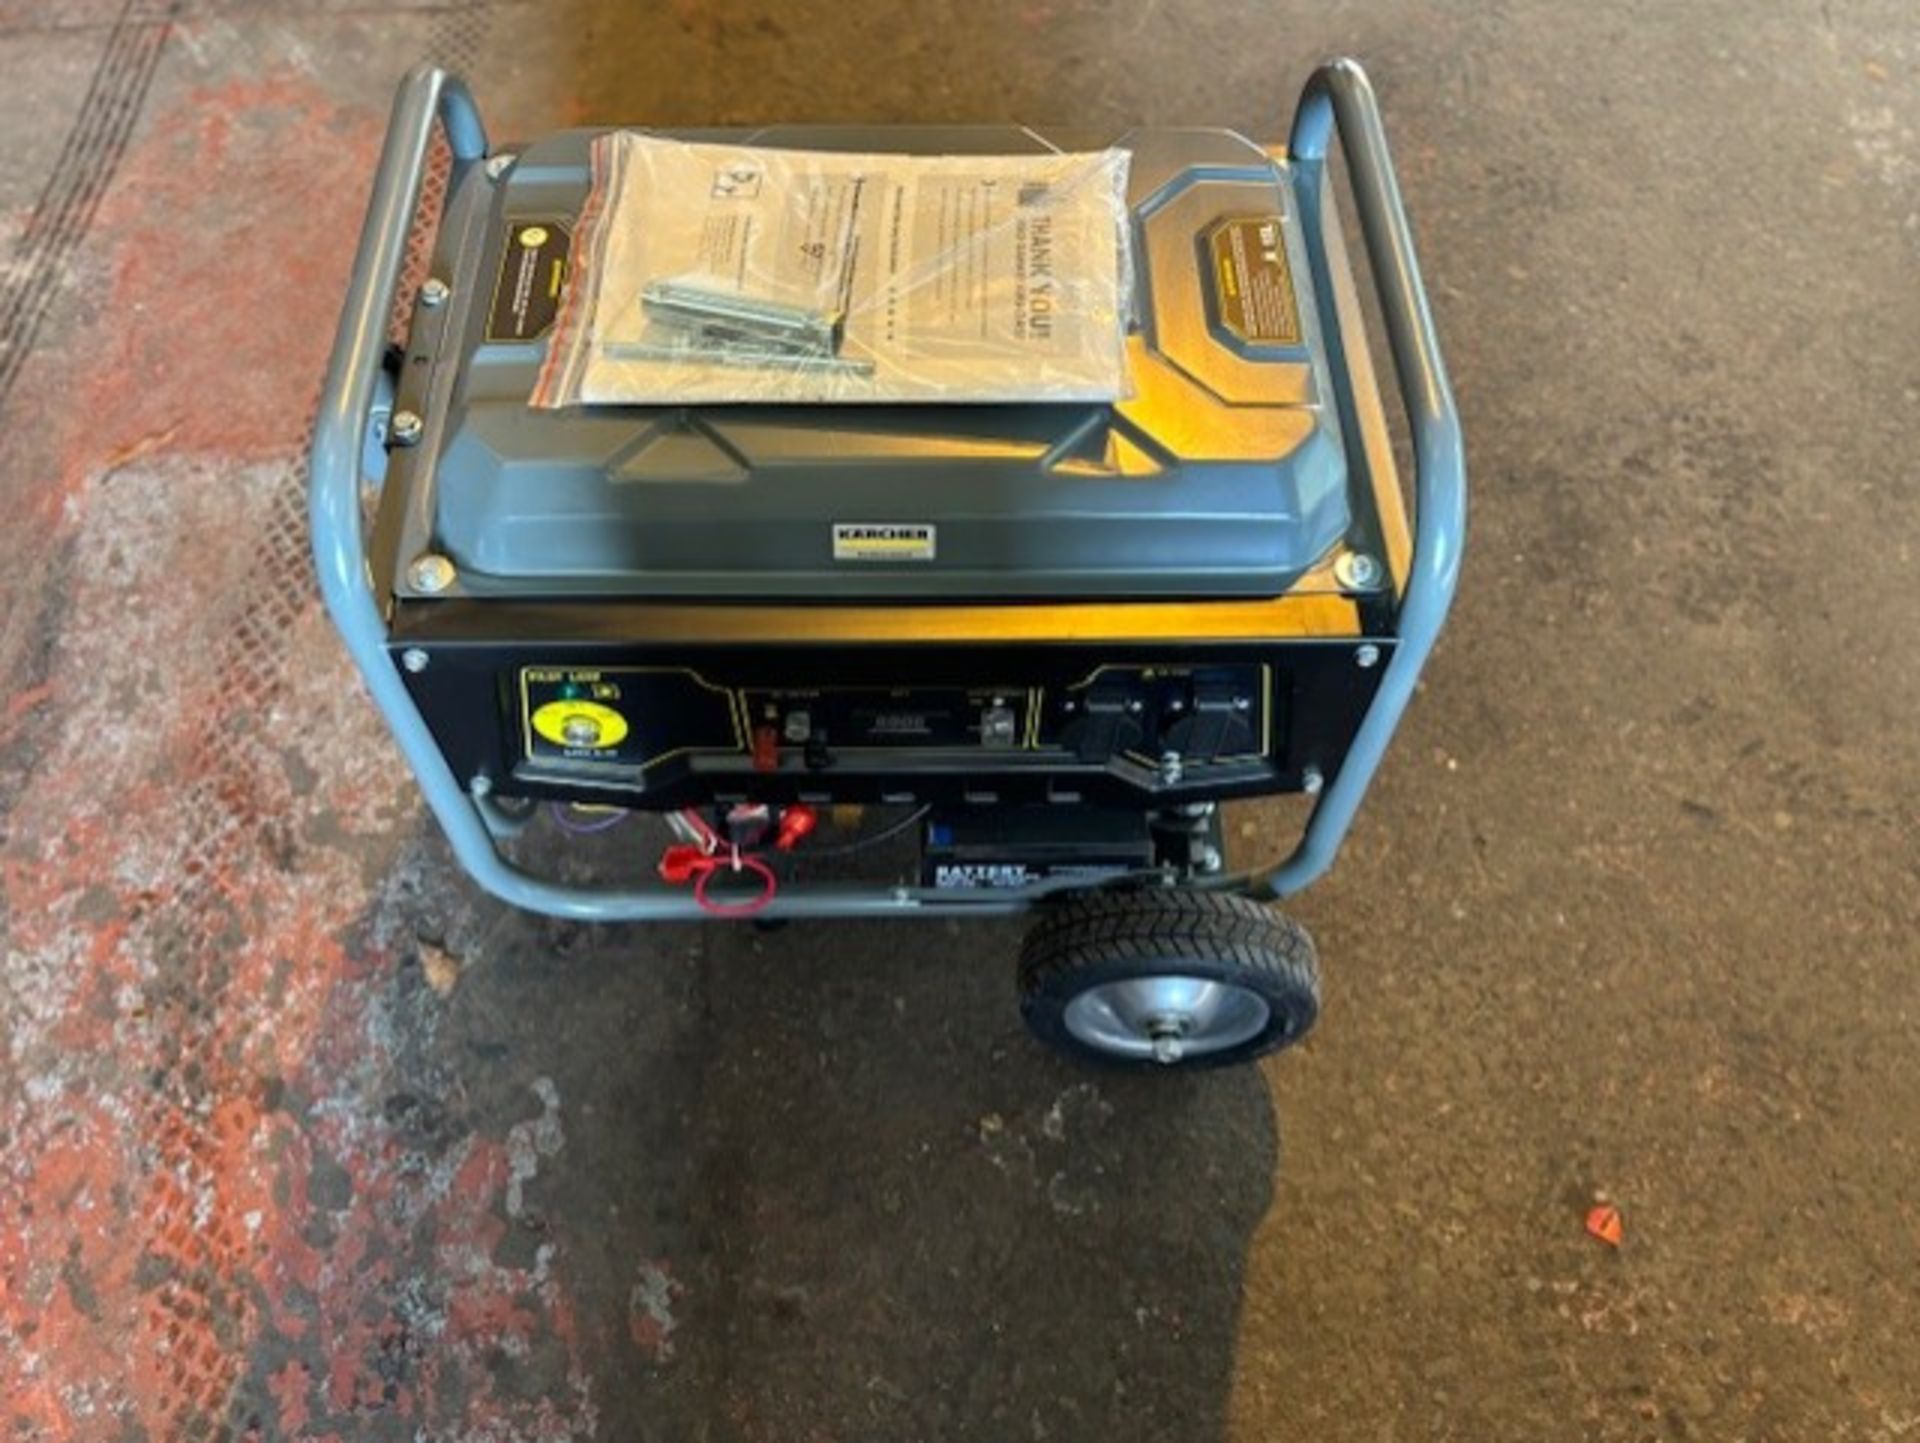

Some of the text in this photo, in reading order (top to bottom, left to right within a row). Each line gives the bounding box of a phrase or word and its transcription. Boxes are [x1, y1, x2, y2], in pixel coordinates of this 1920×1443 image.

[1030, 216, 1052, 340] THANK YOU!
[935, 864, 1027, 878] BATTERY
